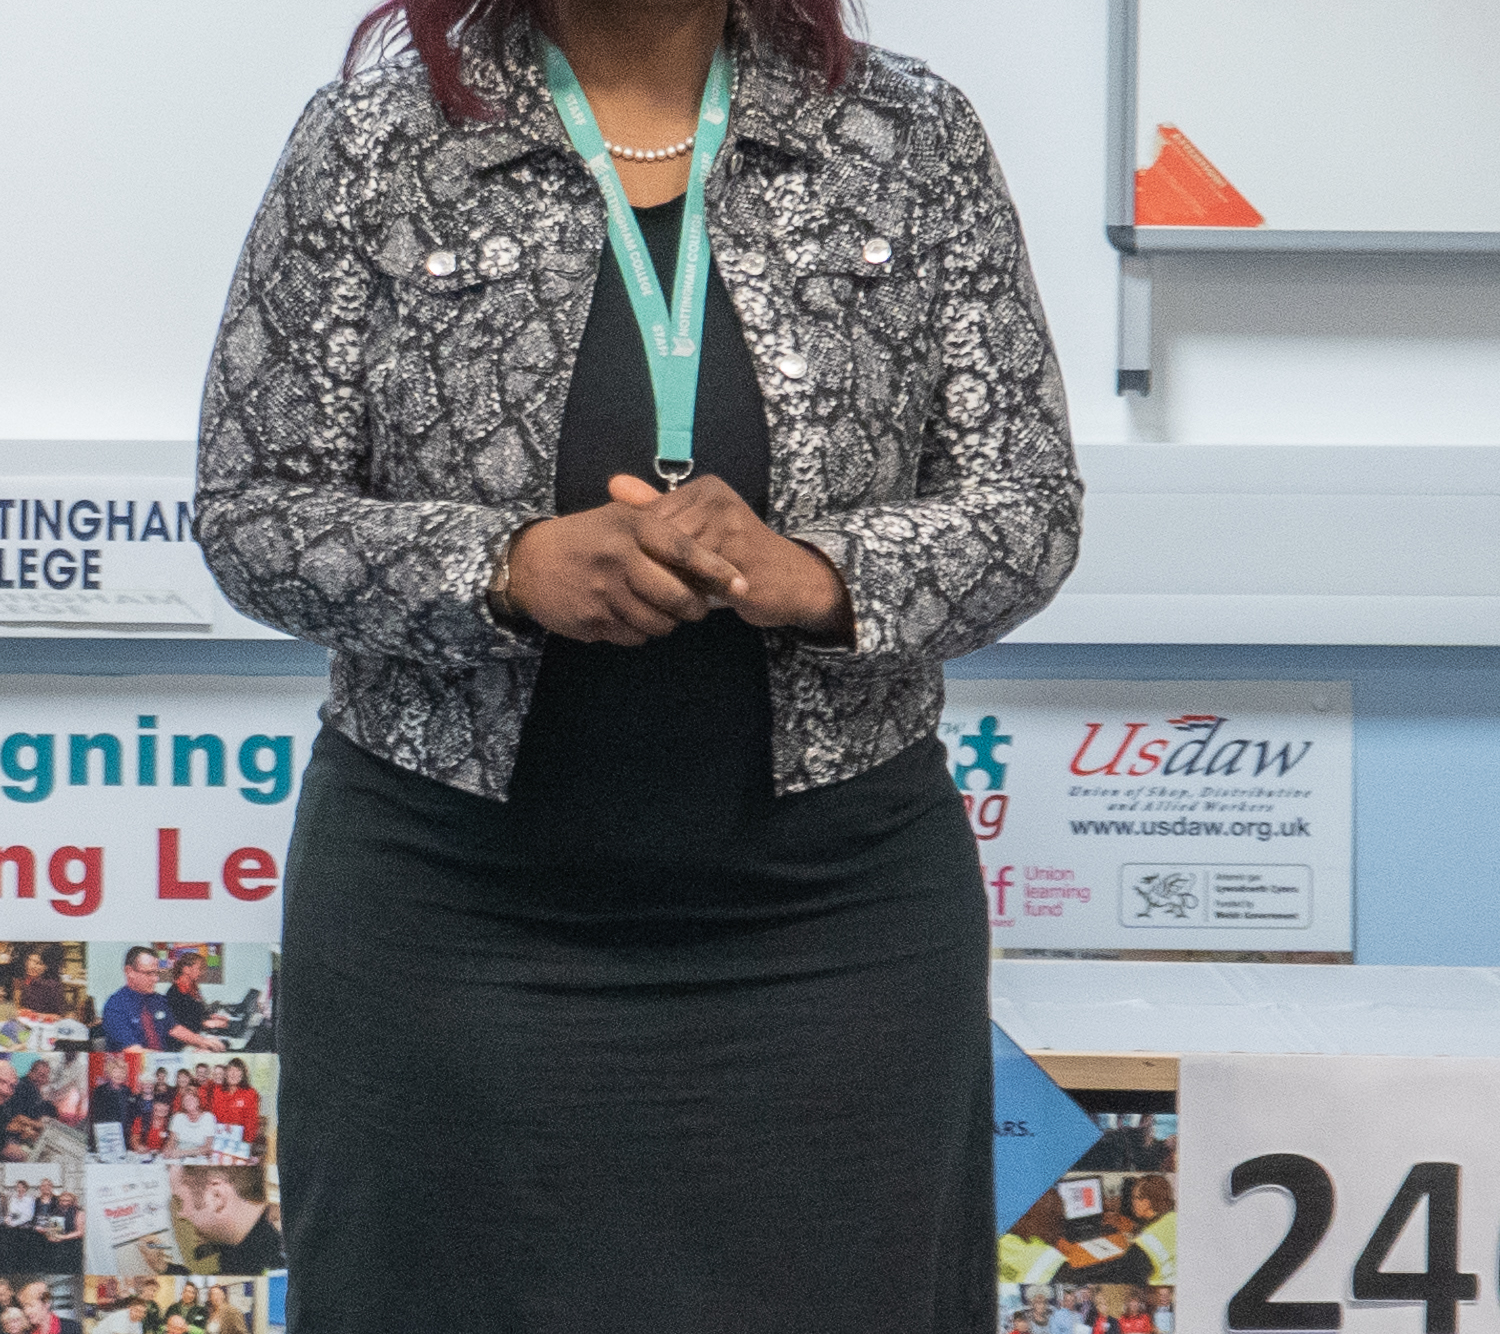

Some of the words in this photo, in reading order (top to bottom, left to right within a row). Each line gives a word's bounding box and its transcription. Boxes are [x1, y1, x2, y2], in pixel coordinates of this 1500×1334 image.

[600, 174, 637, 251] NOTTINGHAM
[629, 251, 655, 297] COLLEGE
[1068, 714, 1314, 777] Usdaw
[1070, 815, 1311, 842] www.usdaw.org.uk
[155, 827, 279, 902] Le
